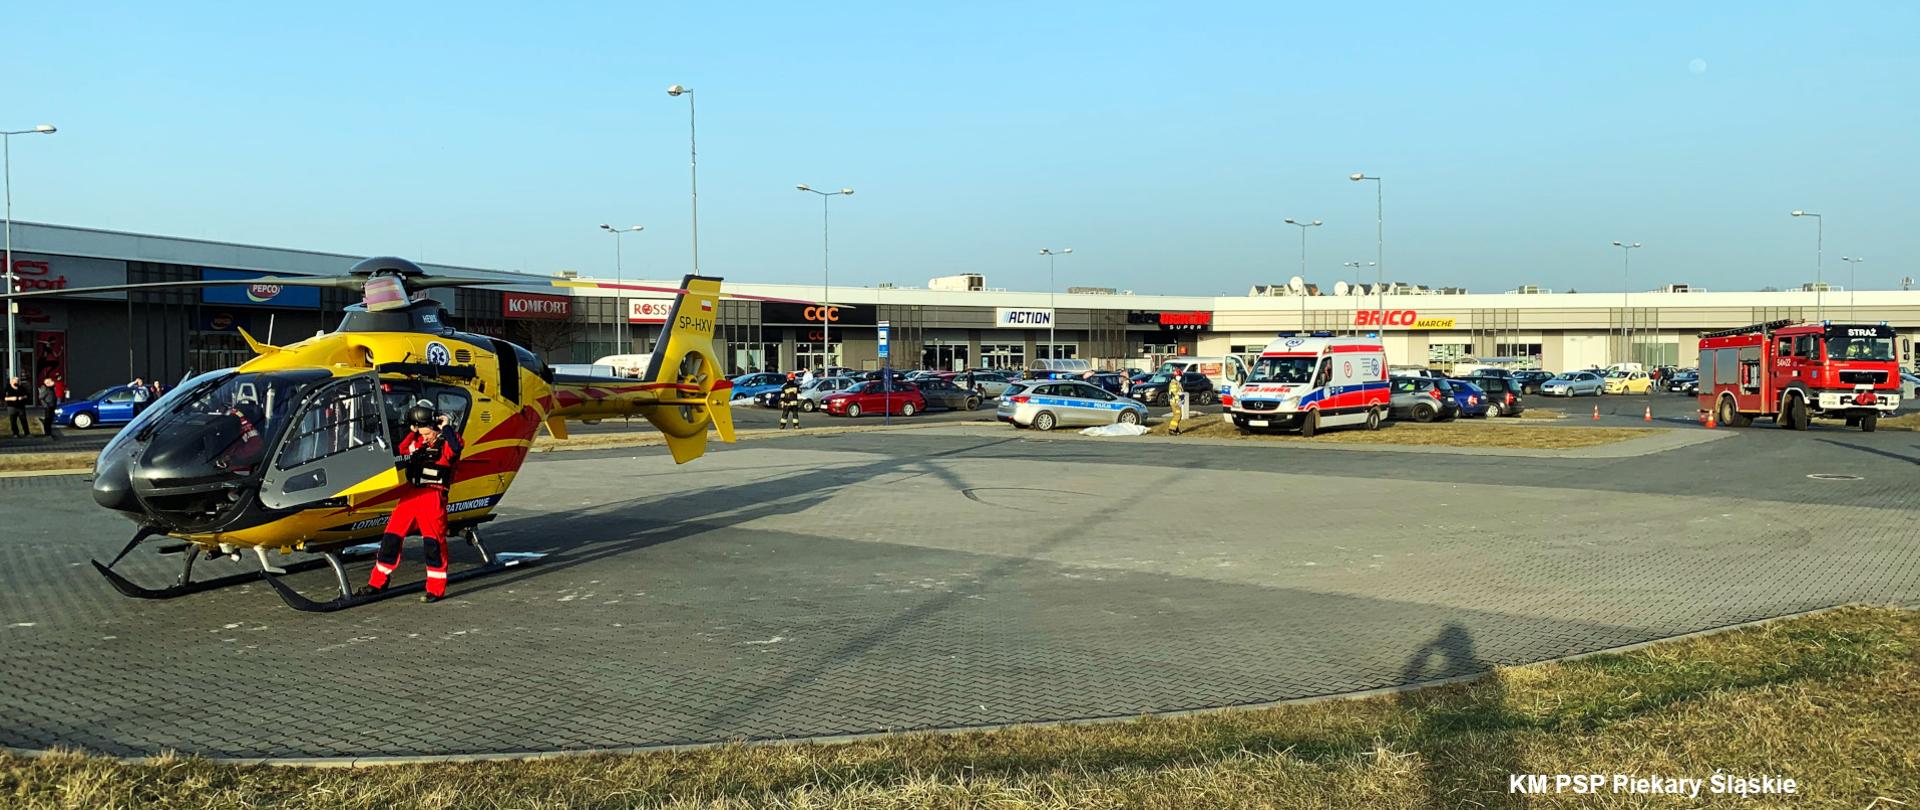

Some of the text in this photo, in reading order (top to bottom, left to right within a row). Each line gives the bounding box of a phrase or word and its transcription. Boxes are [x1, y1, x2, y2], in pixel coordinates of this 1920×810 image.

[252, 284, 278, 294] PEPCO
[509, 298, 568, 314] KOMFORT
[634, 303, 673, 315] ROSS
[803, 306, 839, 322] CCC
[1008, 311, 1051, 325] ACTION
[1355, 310, 1417, 326] BRICO
[679, 316, 713, 332] SP-HXV
[1848, 328, 1877, 337] STRAŻ
